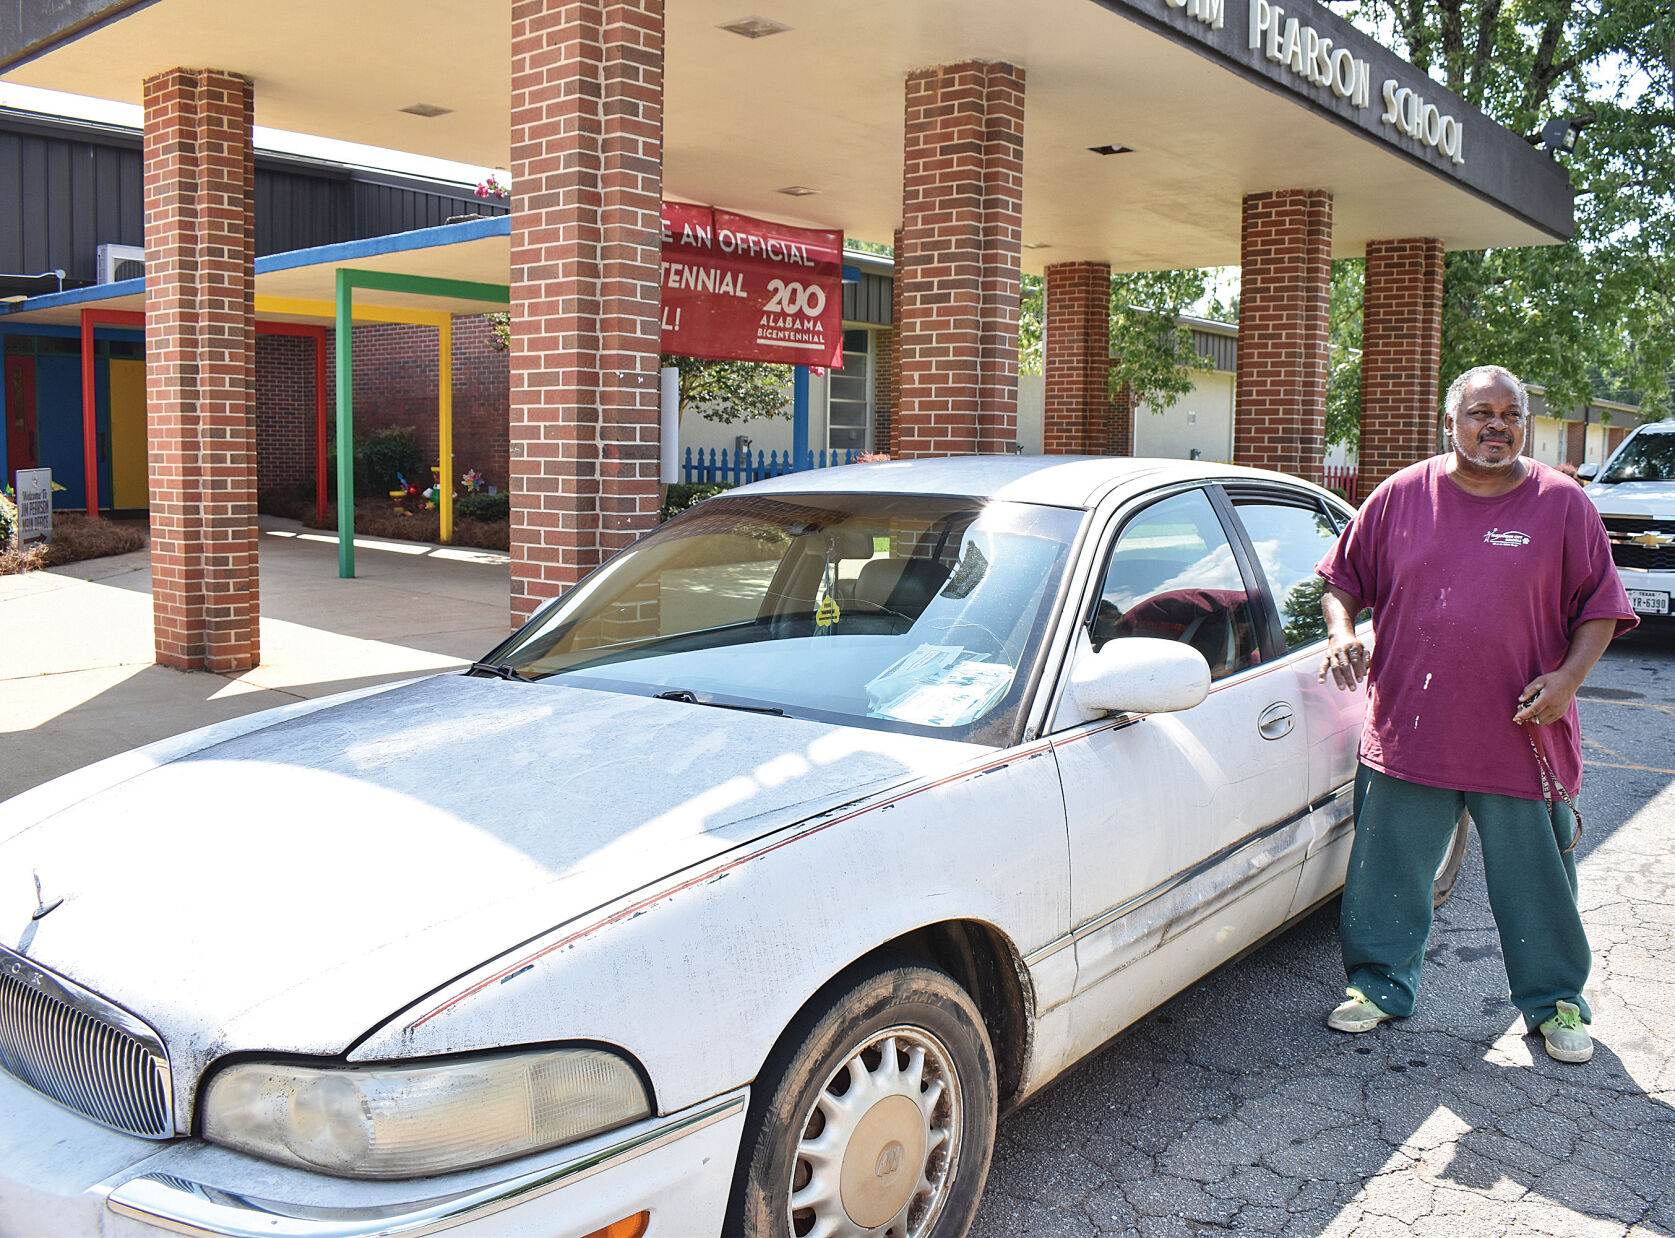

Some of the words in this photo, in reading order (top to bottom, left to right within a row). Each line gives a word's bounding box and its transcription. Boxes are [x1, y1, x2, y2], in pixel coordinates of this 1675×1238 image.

[1249, 0, 1370, 108] PEARSON
[1382, 79, 1465, 165] SCHOOL
[680, 223, 712, 249] AN
[719, 229, 815, 267] OFFICIAL
[762, 278, 826, 318] 200
[759, 314, 824, 332] ALABAMA
[757, 327, 825, 343] BICENTENNIAL
[22, 490, 41, 501] Welcome
[21, 502, 29, 517] JIM
[29, 500, 49, 516] PEARSON
[34, 515, 49, 531] OFFICE
